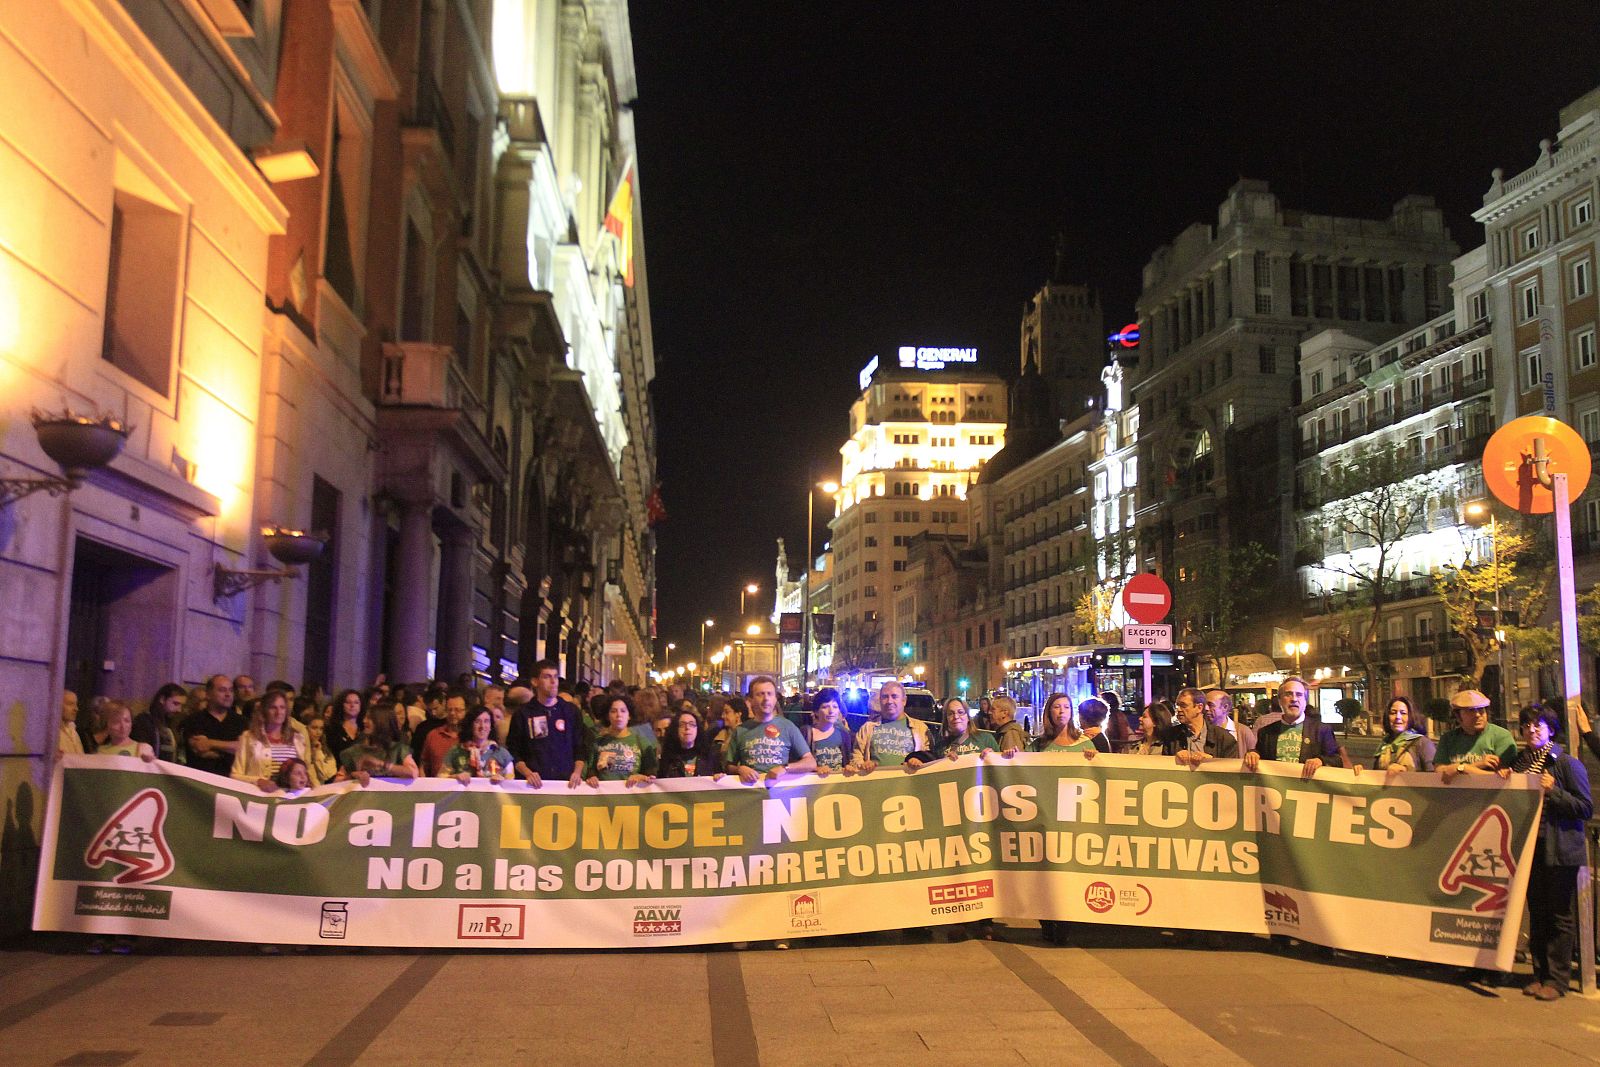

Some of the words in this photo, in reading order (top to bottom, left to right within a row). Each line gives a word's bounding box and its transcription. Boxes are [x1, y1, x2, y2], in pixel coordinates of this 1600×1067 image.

[917, 347, 977, 362] GENERALI
[1128, 628, 1167, 637] EXCEPTO
[212, 793, 330, 846] NO
[348, 809, 393, 847] a
[412, 802, 480, 849] la
[500, 801, 743, 850] LOMCE.
[762, 793, 864, 845] NO
[881, 795, 924, 833] a
[938, 781, 1038, 828] los
[1056, 777, 1413, 849] RECORTES
[367, 857, 444, 891] NO
[455, 863, 482, 890] a
[494, 858, 563, 892] las
[574, 831, 992, 892] CONTRARREFORMAS
[1000, 831, 1260, 875] EDUCATIVAS
[931, 885, 978, 901] CCOO
[1088, 885, 1112, 899] UGT
[1119, 889, 1137, 898] FETE
[135, 905, 167, 914] Madrid
[1264, 909, 1300, 926] STEM
[468, 916, 513, 937] mRp
